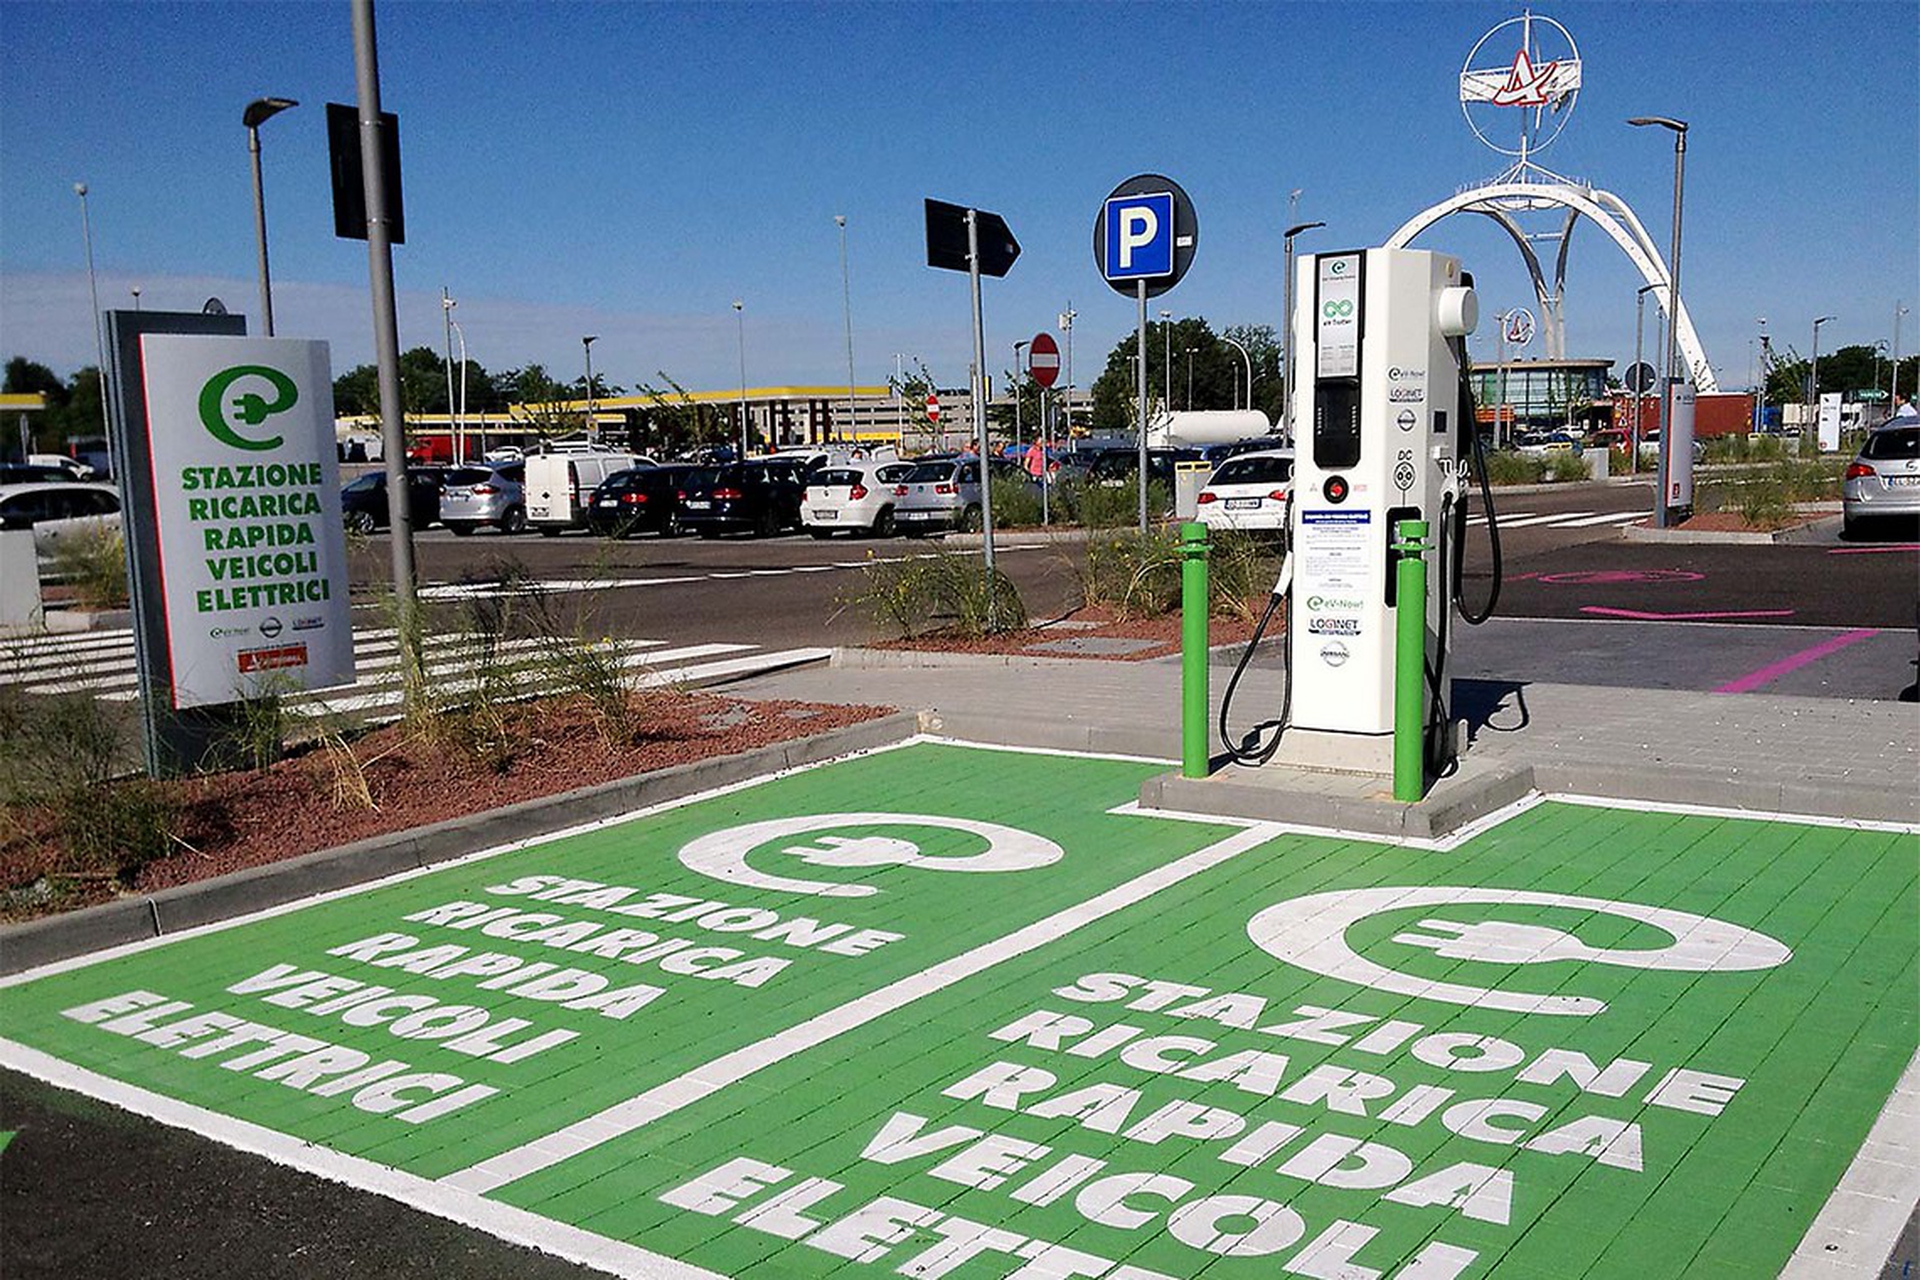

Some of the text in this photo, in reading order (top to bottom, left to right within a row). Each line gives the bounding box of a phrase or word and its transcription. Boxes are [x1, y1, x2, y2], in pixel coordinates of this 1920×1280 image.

[1119, 206, 1158, 269] P
[182, 462, 322, 491] STAZIONE
[1398, 450, 1413, 461] DC
[188, 493, 322, 521] RICARICA
[203, 522, 314, 551] RAPIDA
[197, 579, 330, 613] ELETTRICI
[206, 551, 318, 581] VEICOLI
[402, 900, 793, 988] RICARICA
[485, 875, 905, 957] STAZIONE
[226, 963, 580, 1065] VEICOLI
[326, 932, 666, 1020] RAPIDA
[60, 989, 500, 1125] ELETTRICI
[1051, 972, 1746, 1117] STAZIONE
[988, 1009, 1644, 1173] RICARICA
[941, 1060, 1515, 1226] RAPIDA
[657, 1156, 1180, 1280] ELETT
[859, 1110, 1480, 1280] VEICOLI
